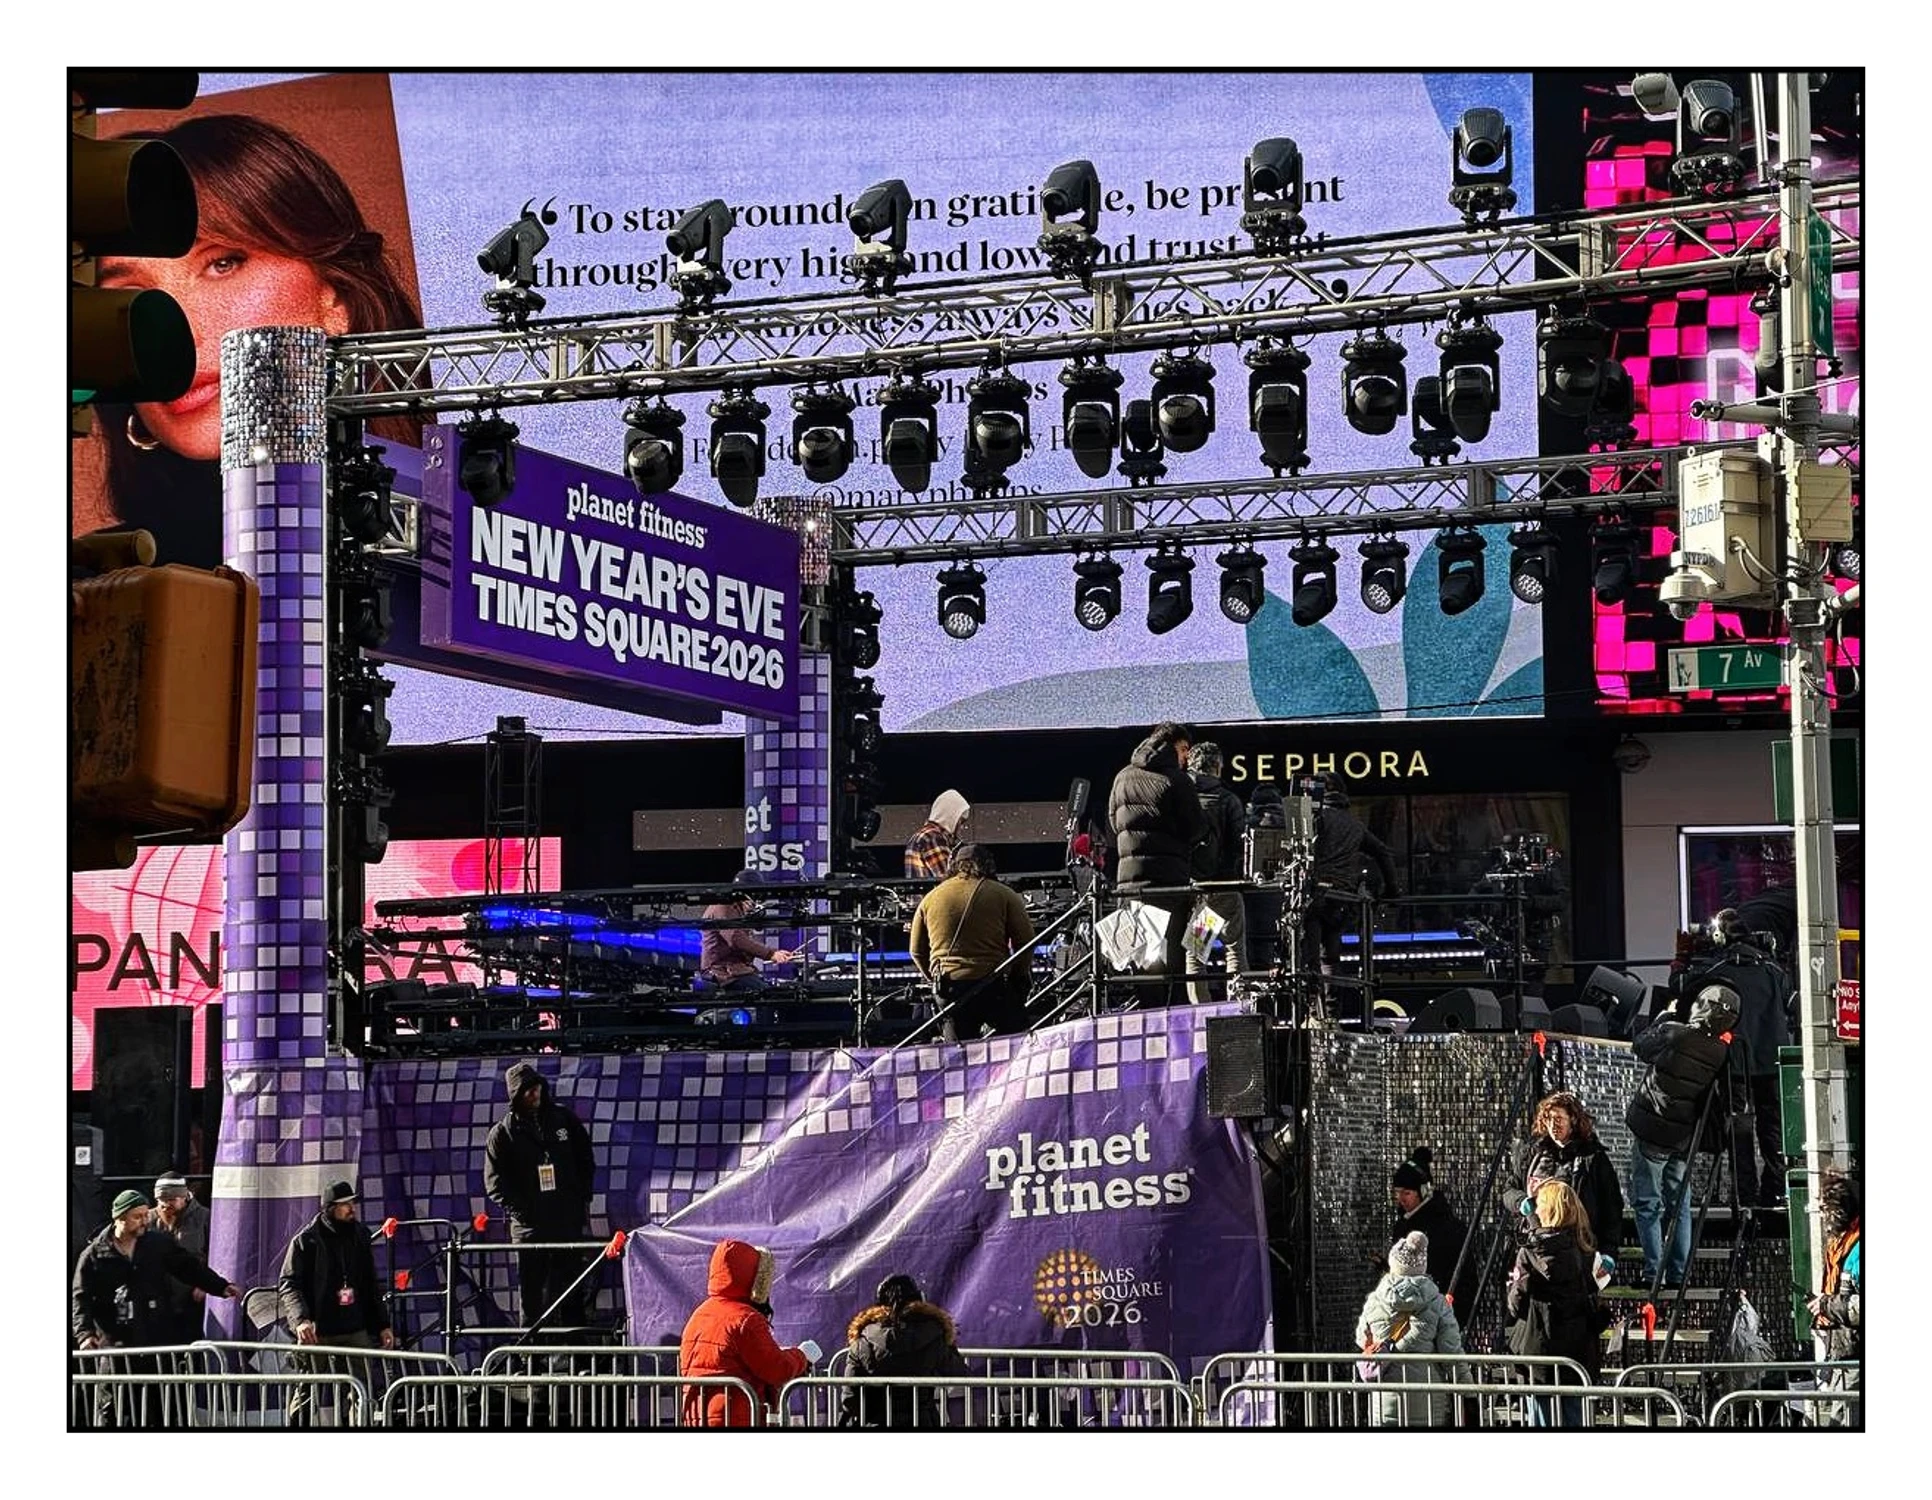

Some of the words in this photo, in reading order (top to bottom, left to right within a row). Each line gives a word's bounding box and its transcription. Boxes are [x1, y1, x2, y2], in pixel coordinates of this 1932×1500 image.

[569, 204, 613, 233] To
[729, 194, 855, 228] round
[947, 182, 1135, 228] gratie,
[1145, 179, 1190, 211] be
[1200, 175, 1346, 216] prnt
[567, 483, 635, 530] planet
[639, 497, 706, 550] fitness
[471, 506, 565, 583] NEW
[571, 534, 710, 621] YEAR'S
[716, 575, 785, 641] EVE
[471, 573, 578, 641] TIMES
[584, 601, 710, 673] SQUARE
[710, 635, 785, 690] 2026
[1718, 653, 1734, 684] 7
[1744, 651, 1763, 668] Av
[1231, 750, 1430, 782] SEPHORA
[985, 1122, 1151, 1190] planet
[1010, 1171, 1193, 1219] fitness
[1080, 1267, 1136, 1285] TIMES
[1092, 1281, 1163, 1302] SQUARE
[1066, 1300, 1142, 1329] 2026
